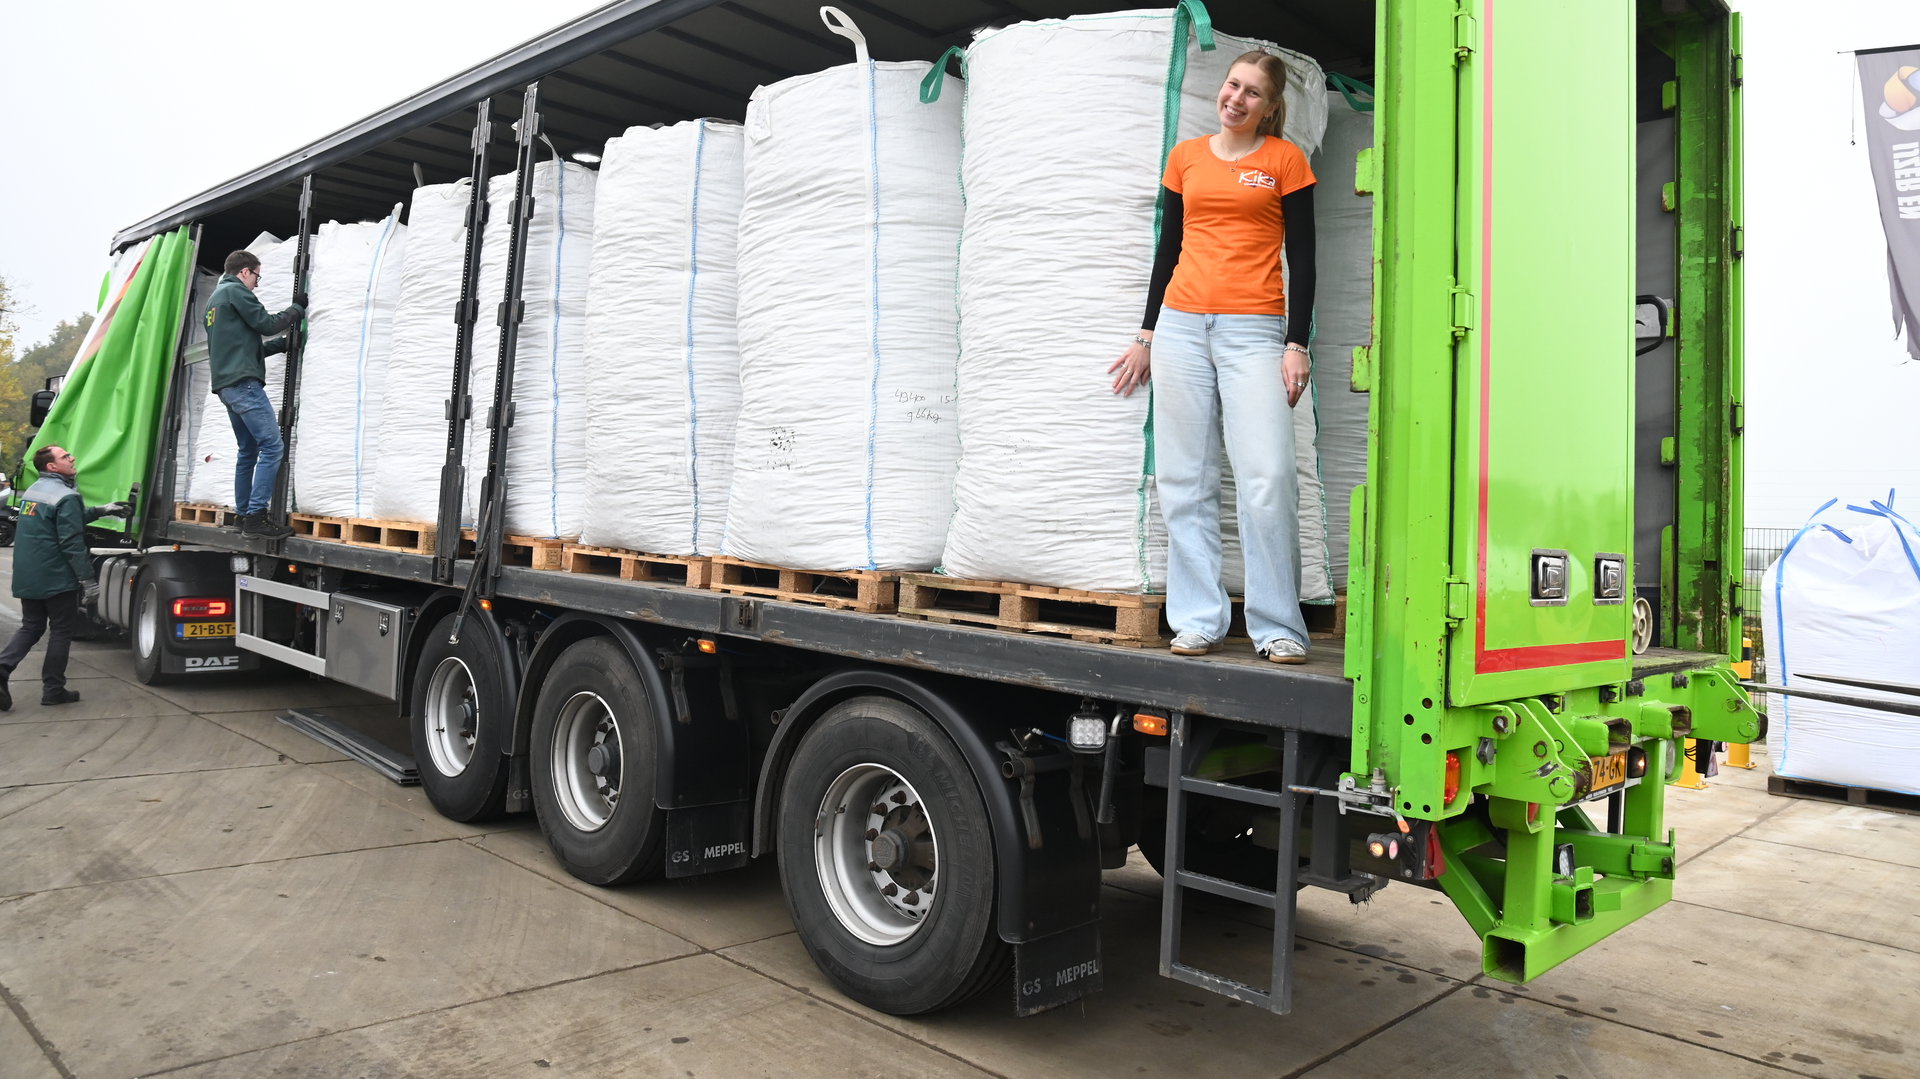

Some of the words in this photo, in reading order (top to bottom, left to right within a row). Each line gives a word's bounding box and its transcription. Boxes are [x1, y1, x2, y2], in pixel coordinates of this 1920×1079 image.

[185, 655, 239, 668] DAF
[671, 850, 690, 863] GS
[704, 841, 746, 860] MEPPEL
[1022, 978, 1042, 996] GS
[1056, 959, 1099, 987] MEPPEL
